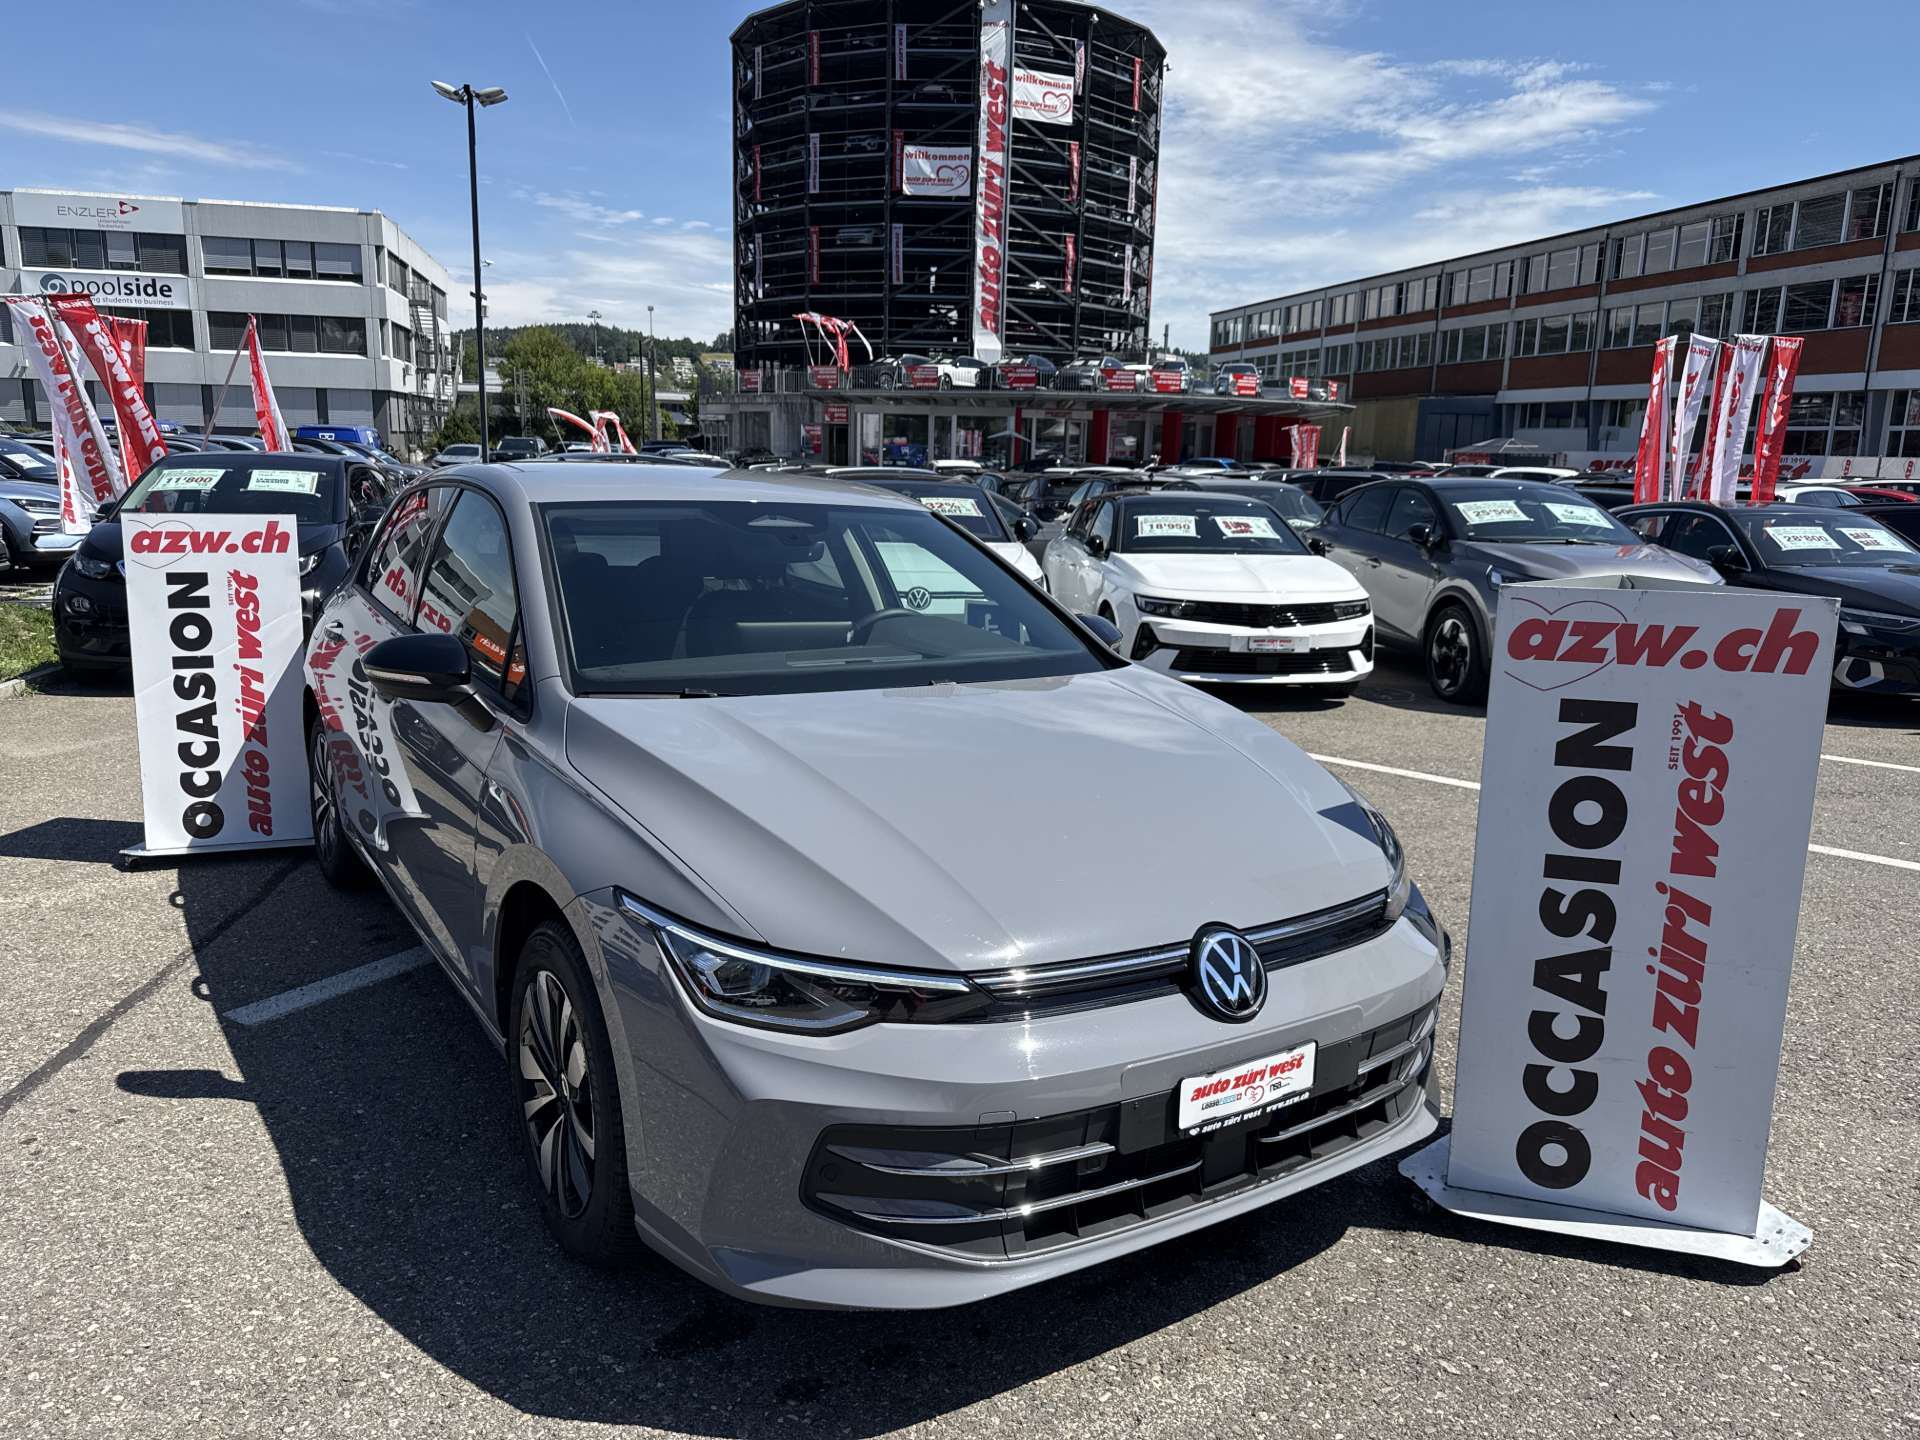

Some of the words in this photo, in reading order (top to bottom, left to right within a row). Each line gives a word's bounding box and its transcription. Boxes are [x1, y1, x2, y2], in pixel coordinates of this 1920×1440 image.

[985, 59, 1008, 153] west
[1015, 73, 1073, 90] willkommen
[905, 150, 970, 161] willkommen
[56, 206, 117, 218] ENZLER
[978, 156, 1004, 243] züri
[71, 276, 173, 298] poolside
[102, 296, 133, 305] students
[134, 297, 142, 305] to
[143, 298, 174, 306] business
[979, 245, 1001, 334] auto
[165, 476, 213, 484] 11'800
[131, 520, 291, 554] azw.ch
[1149, 522, 1191, 530] 18'950
[1783, 534, 1828, 543] 28'800
[227, 568, 263, 660] west
[1506, 608, 1820, 676] azw.ch
[165, 571, 225, 840] OCCASION
[233, 663, 269, 748] züri
[1671, 714, 1684, 741] 1991
[1668, 746, 1681, 771] SEIT
[240, 750, 273, 837] auto
[1669, 699, 1734, 879] west
[1515, 697, 1639, 1190] OCCASION
[1646, 880, 1713, 1050] züri
[1190, 1077, 1231, 1103] auto
[1232, 1064, 1269, 1090] züri
[1269, 1053, 1305, 1079] west
[1202, 1121, 1222, 1133] auto
[1223, 1114, 1242, 1128] züri
[1243, 1108, 1262, 1121] west
[1266, 1091, 1310, 1113] www.azw.ch
[1634, 1046, 1693, 1212] auto
